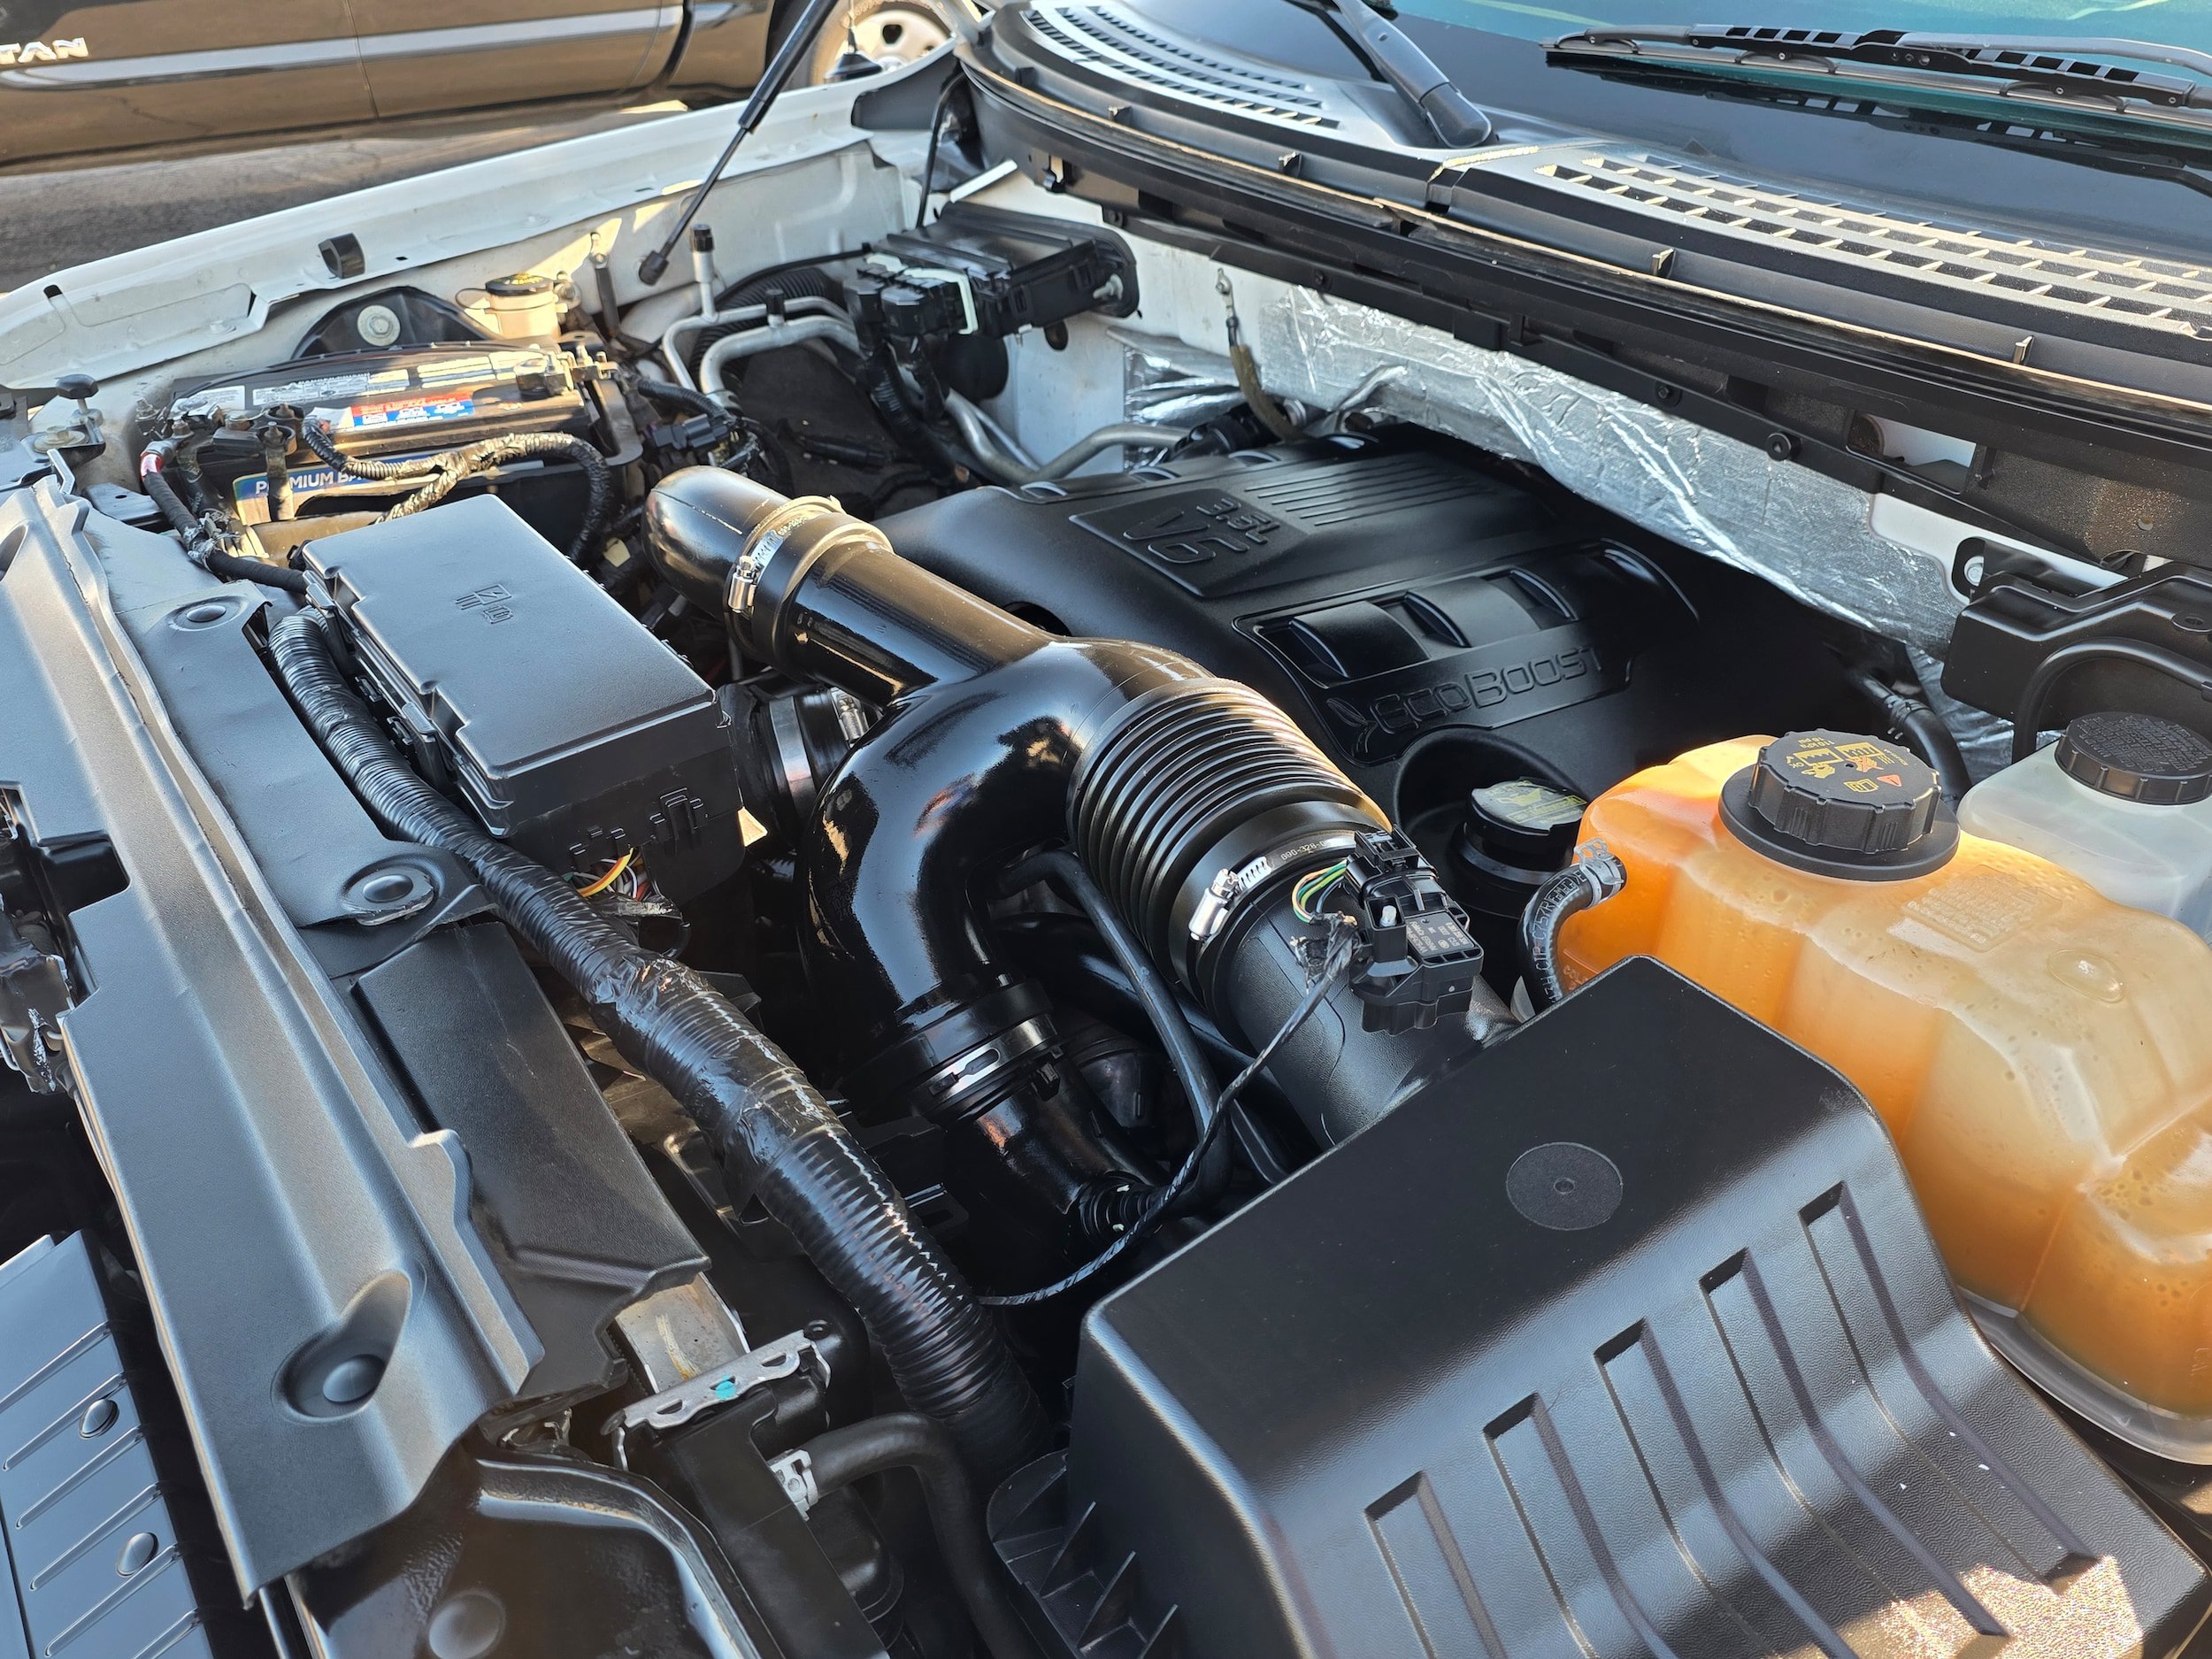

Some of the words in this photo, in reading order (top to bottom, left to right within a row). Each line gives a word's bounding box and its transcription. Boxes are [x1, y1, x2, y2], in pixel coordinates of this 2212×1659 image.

[256, 472, 334, 495] PMIUM
[1123, 508, 1250, 565] V6
[1195, 497, 1281, 544] 3.5L
